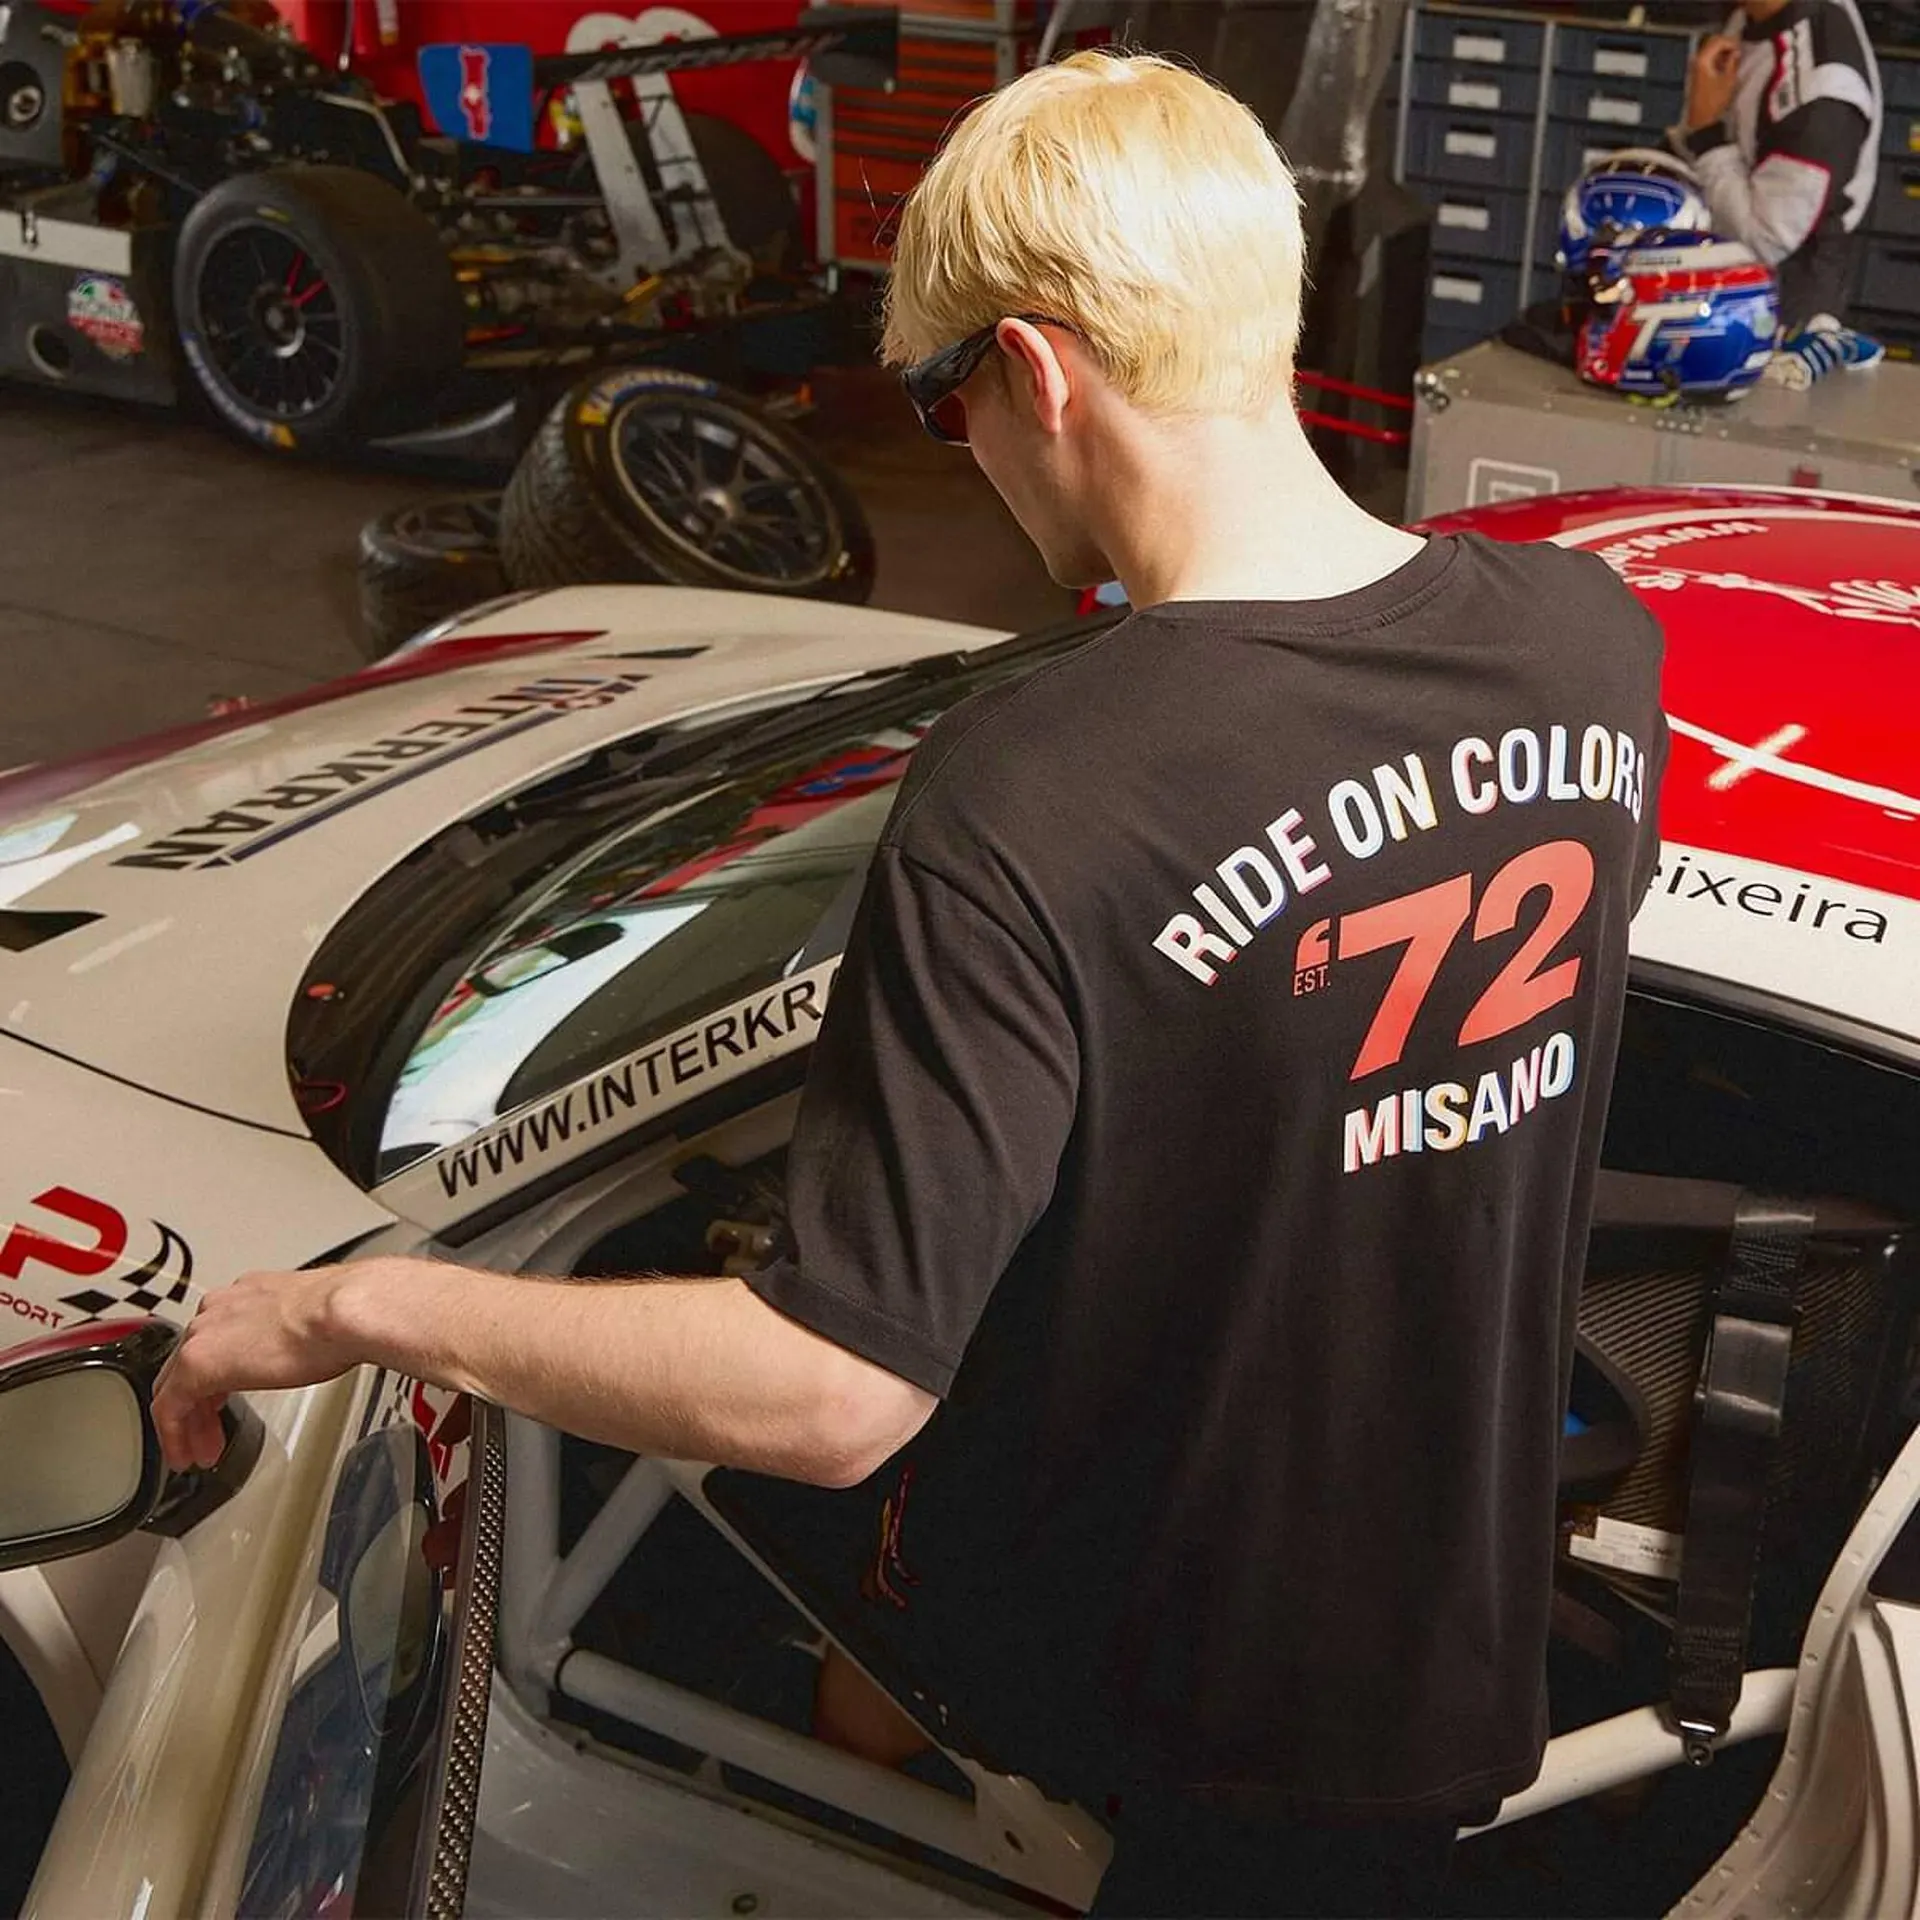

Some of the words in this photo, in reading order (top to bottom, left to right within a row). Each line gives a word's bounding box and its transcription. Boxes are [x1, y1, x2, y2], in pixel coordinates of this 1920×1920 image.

[1153, 807, 1332, 986] RIDE
[1327, 752, 1438, 859] ON
[1451, 724, 1645, 824] COLORS
[1654, 856, 1888, 944] ixeira
[1294, 965, 1331, 996] EST.
[437, 967, 839, 1199] WWW.INTERKR
[1343, 1031, 1576, 1174] MISANO
